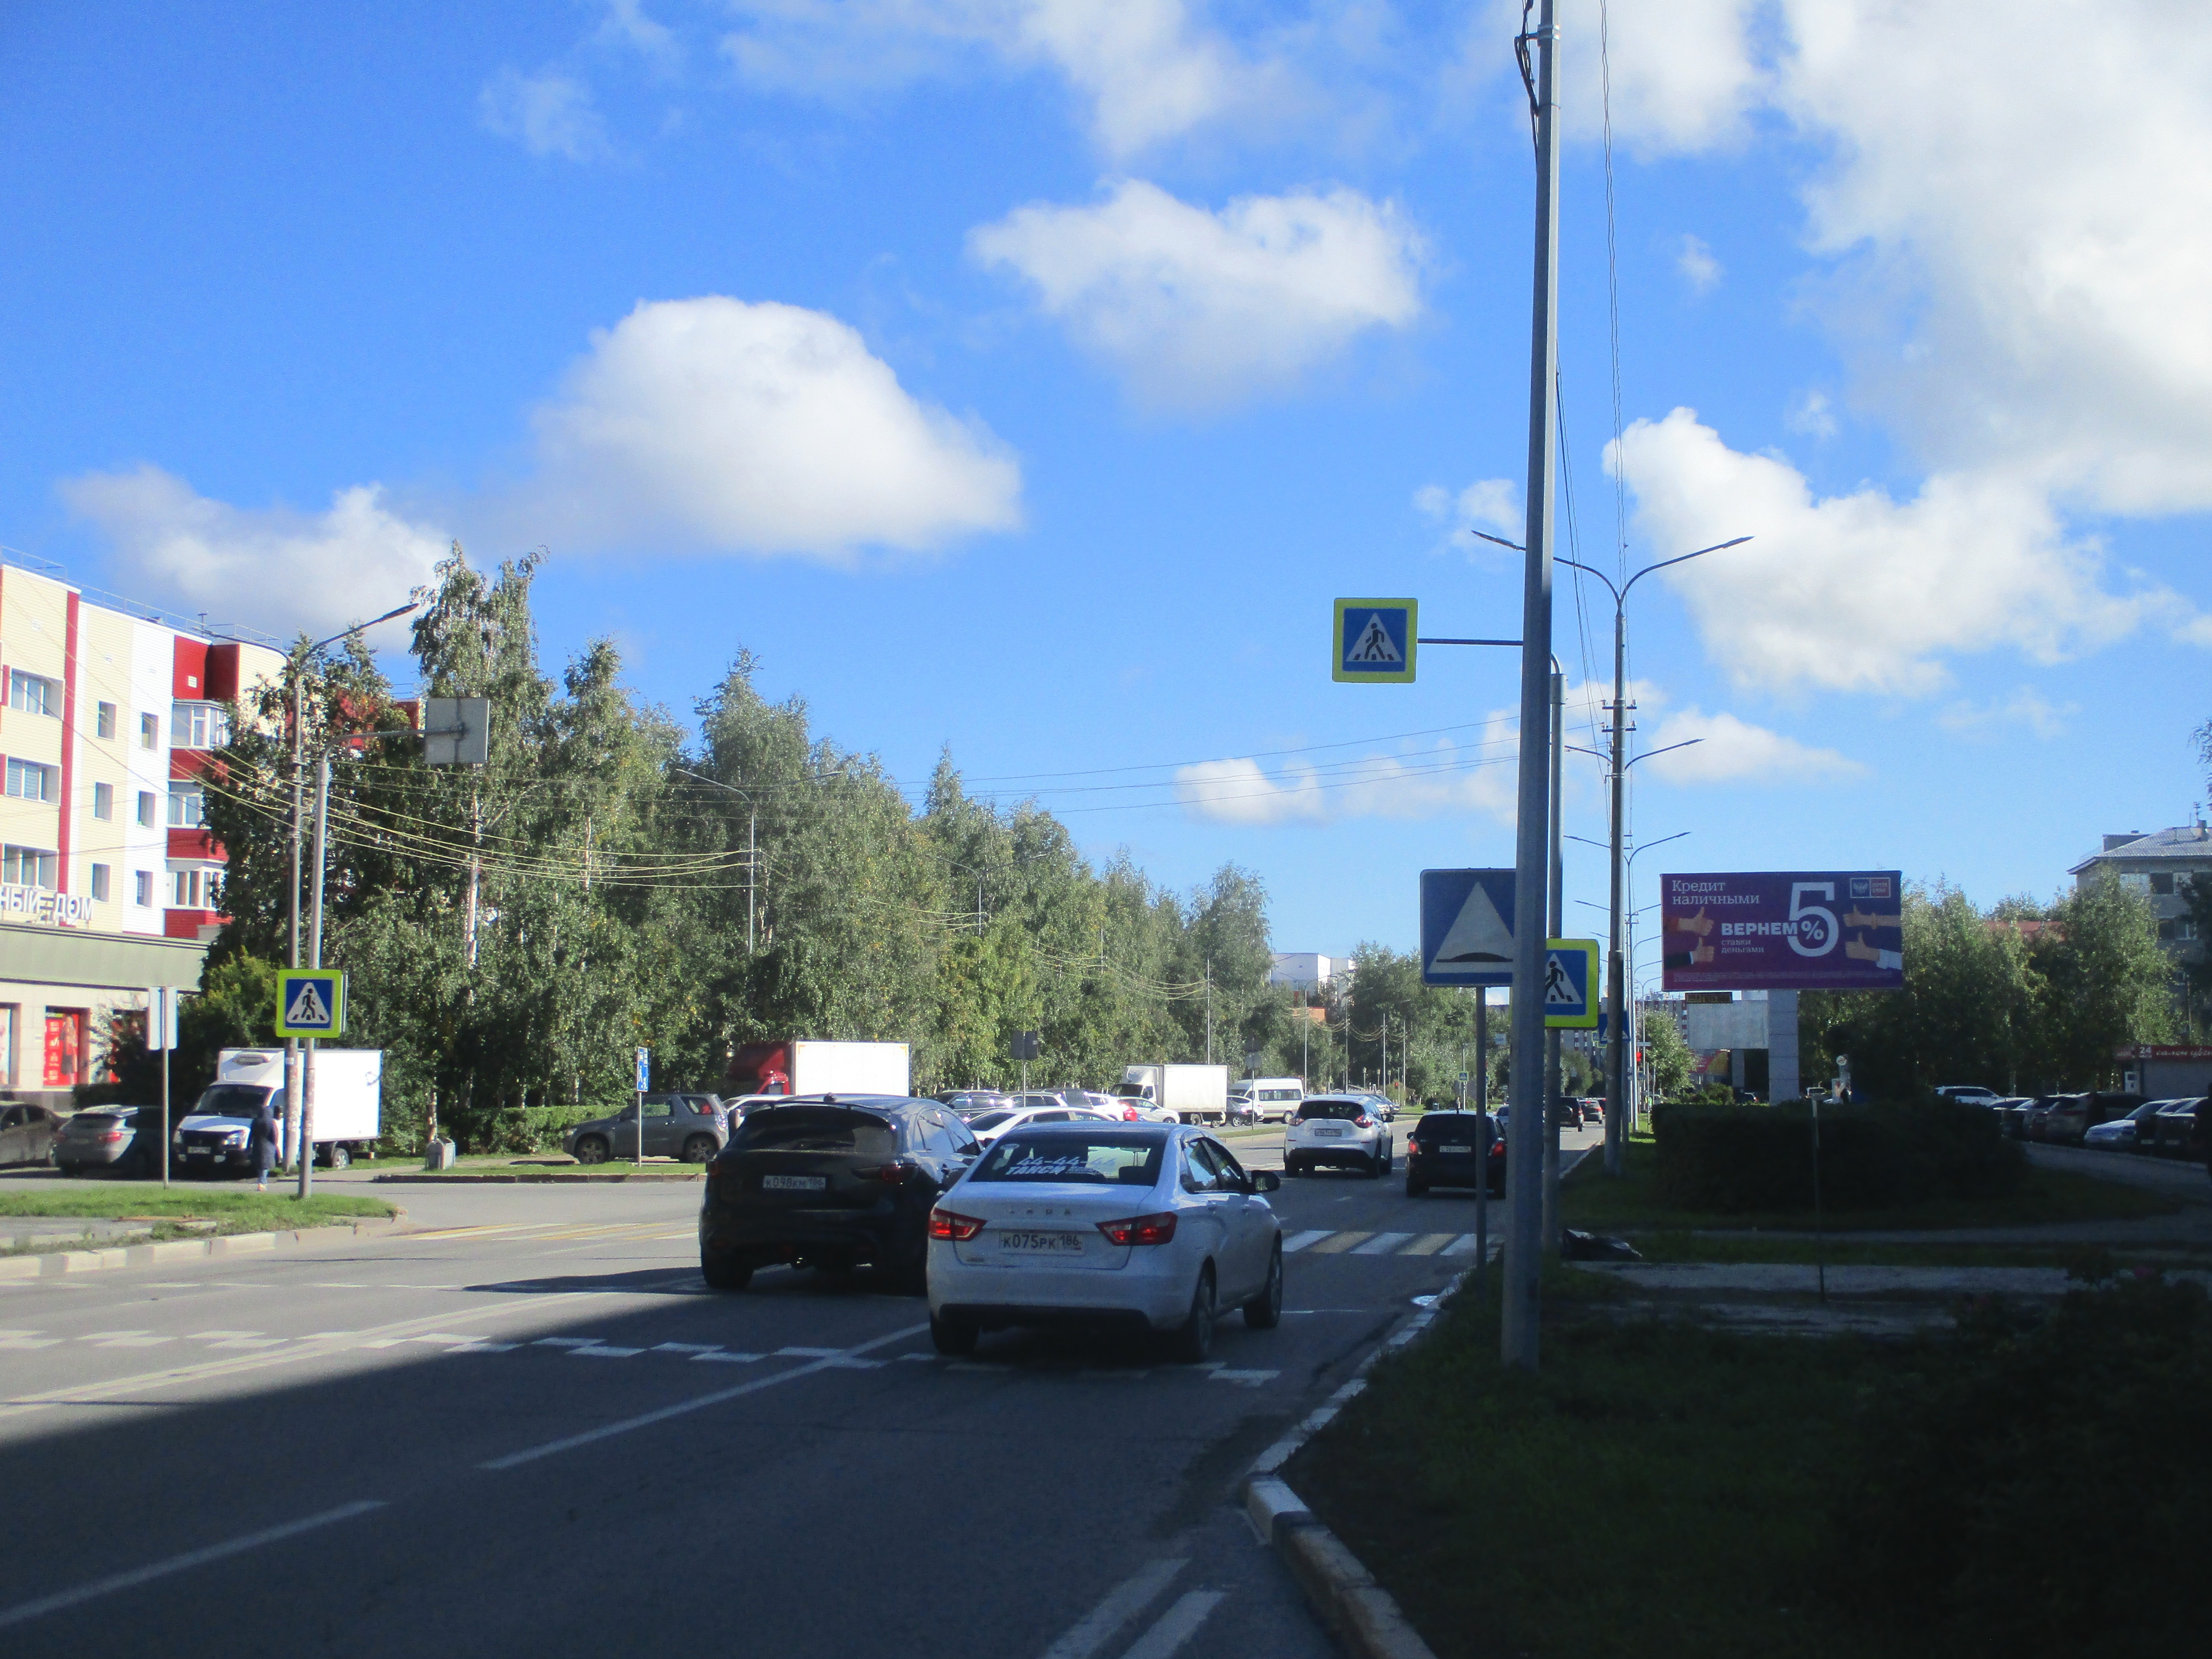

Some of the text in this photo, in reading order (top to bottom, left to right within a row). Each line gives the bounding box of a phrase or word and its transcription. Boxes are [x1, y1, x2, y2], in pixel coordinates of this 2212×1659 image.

[1672, 880, 1725, 894] Кредит
[1672, 895, 1759, 905] наличными
[52, 893, 94, 926] ДОМ
[1722, 923, 1798, 936] ВЕРНЕМ
[1005, 1165, 1067, 1175] ТАКСИ
[1003, 1234, 1079, 1249] К075РК 186
